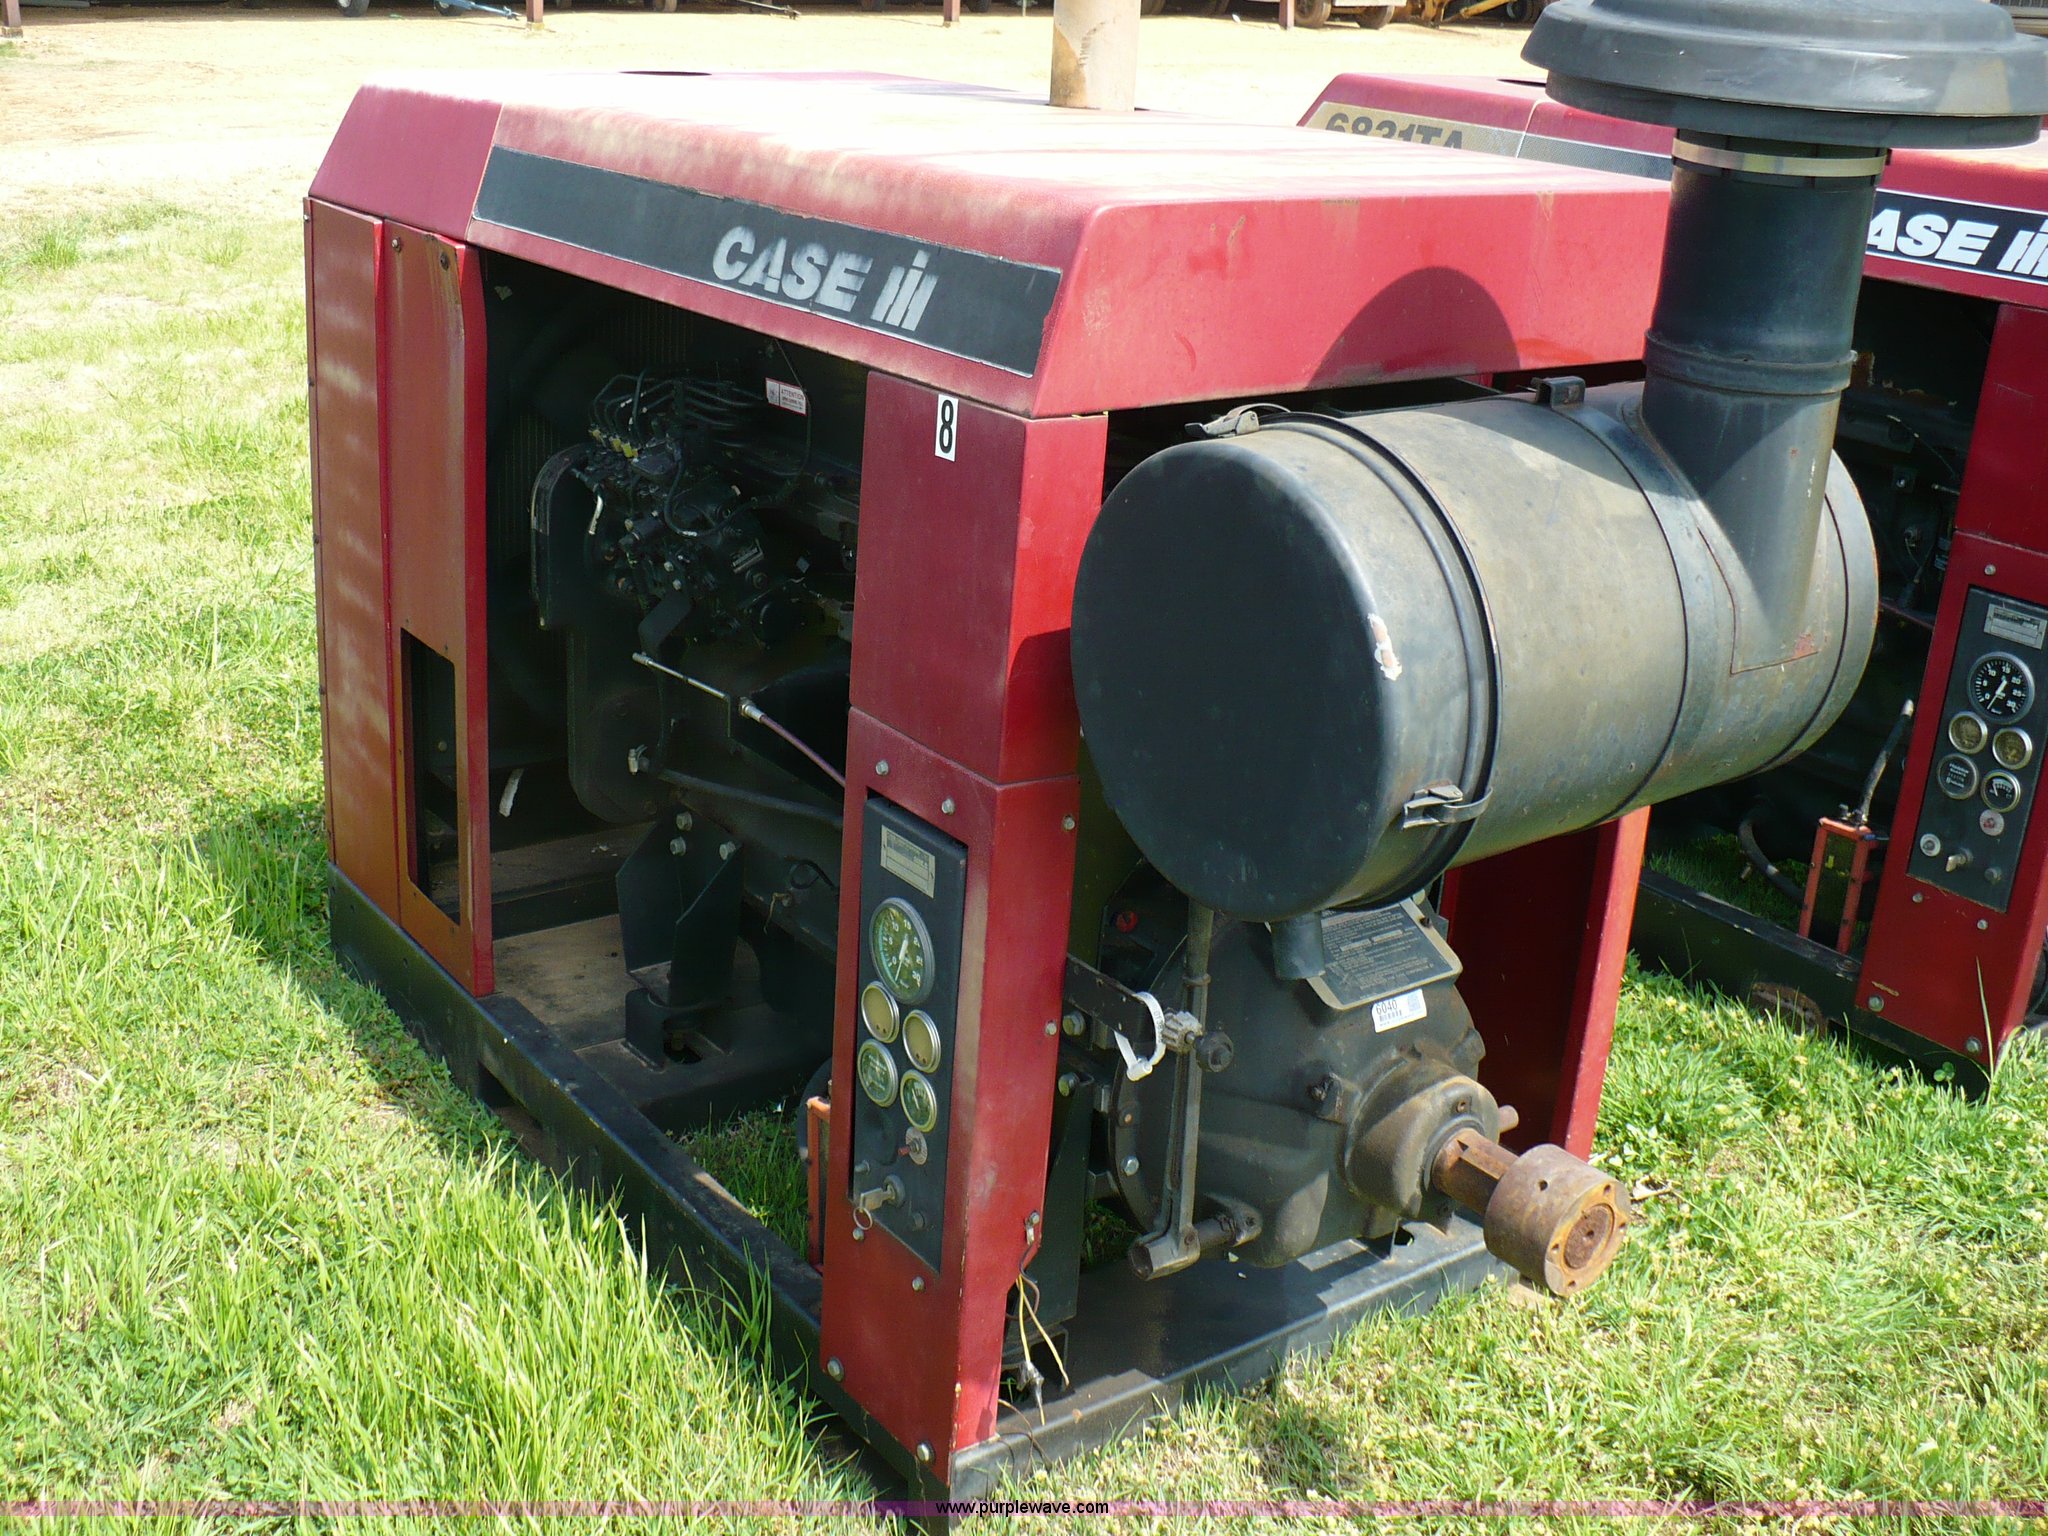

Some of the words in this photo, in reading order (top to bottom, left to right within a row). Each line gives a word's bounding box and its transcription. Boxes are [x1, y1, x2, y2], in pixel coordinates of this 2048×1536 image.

[1867, 208, 1999, 265] ASE
[712, 226, 873, 312] CASE
[938, 399, 955, 454] 8
[1375, 999, 1398, 1016] 6040
